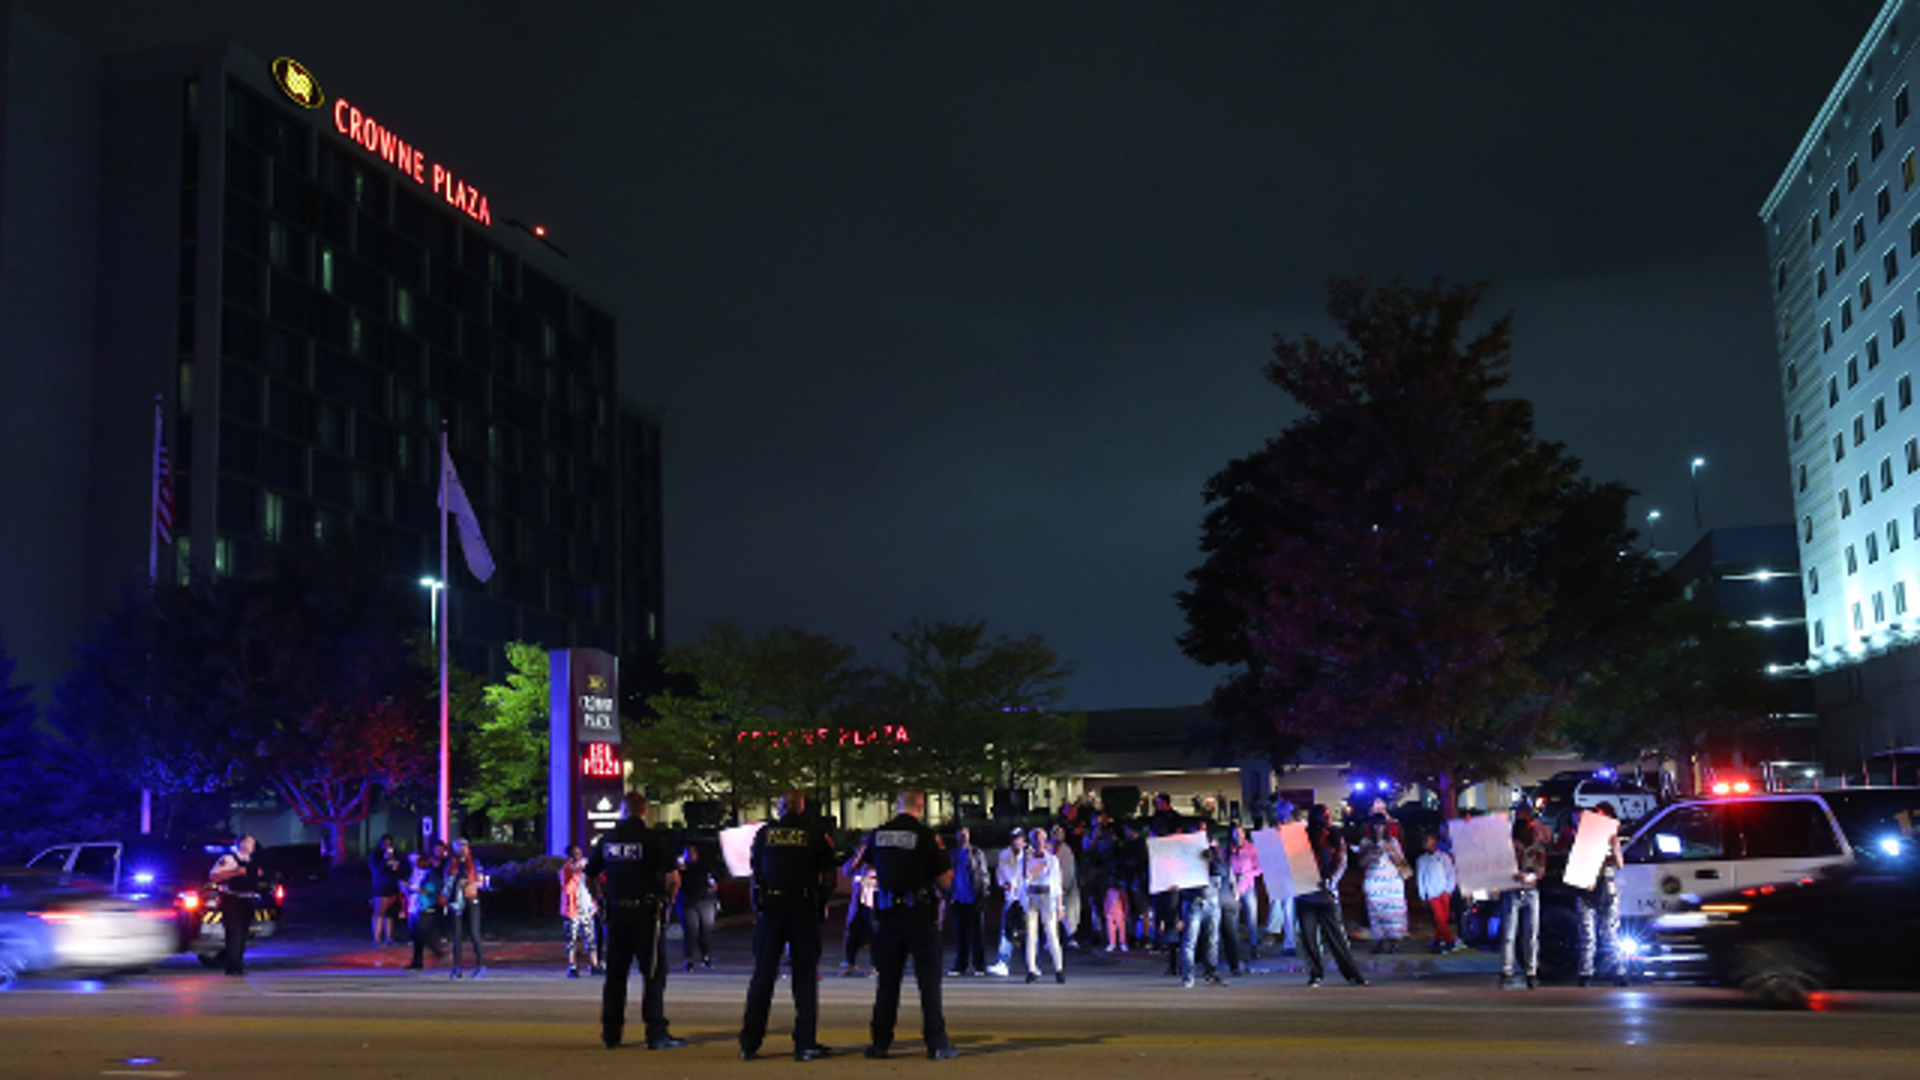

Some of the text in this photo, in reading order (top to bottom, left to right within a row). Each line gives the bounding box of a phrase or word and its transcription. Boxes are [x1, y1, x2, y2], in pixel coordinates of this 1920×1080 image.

[333, 98, 492, 226] CROWNE PLAZA
[768, 829, 806, 845] POLICE
